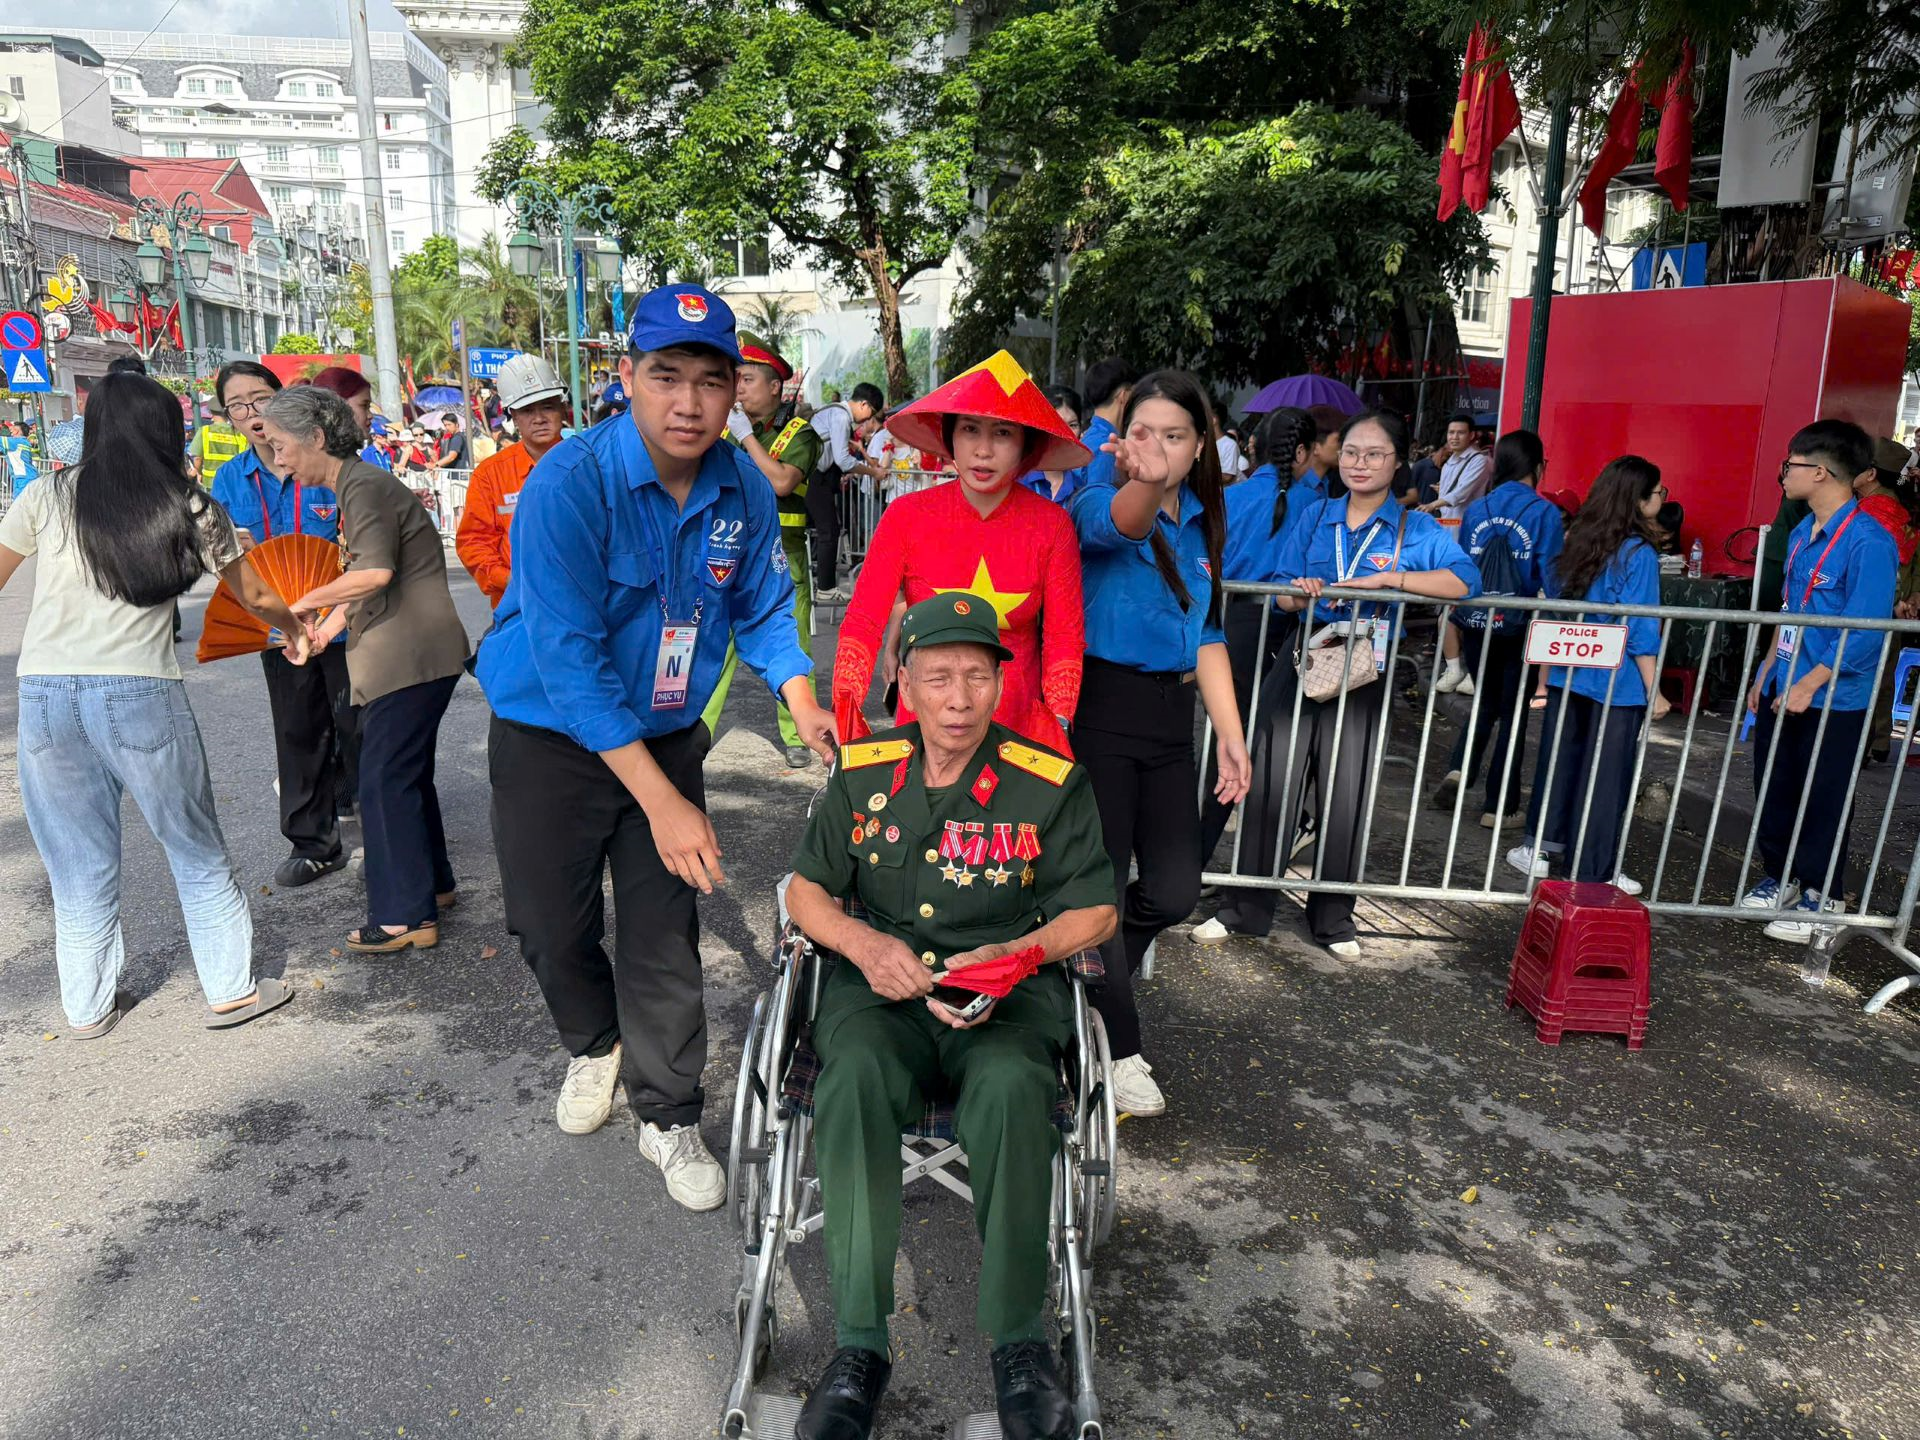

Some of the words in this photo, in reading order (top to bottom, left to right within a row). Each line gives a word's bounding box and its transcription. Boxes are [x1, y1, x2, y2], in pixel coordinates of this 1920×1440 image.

[709, 518, 743, 543] 22
[1559, 627, 1599, 637] POLICE
[1783, 630, 1792, 644] N
[1548, 641, 1603, 658] STOP
[665, 655, 682, 678] N
[656, 693, 673, 703] PHỤC
